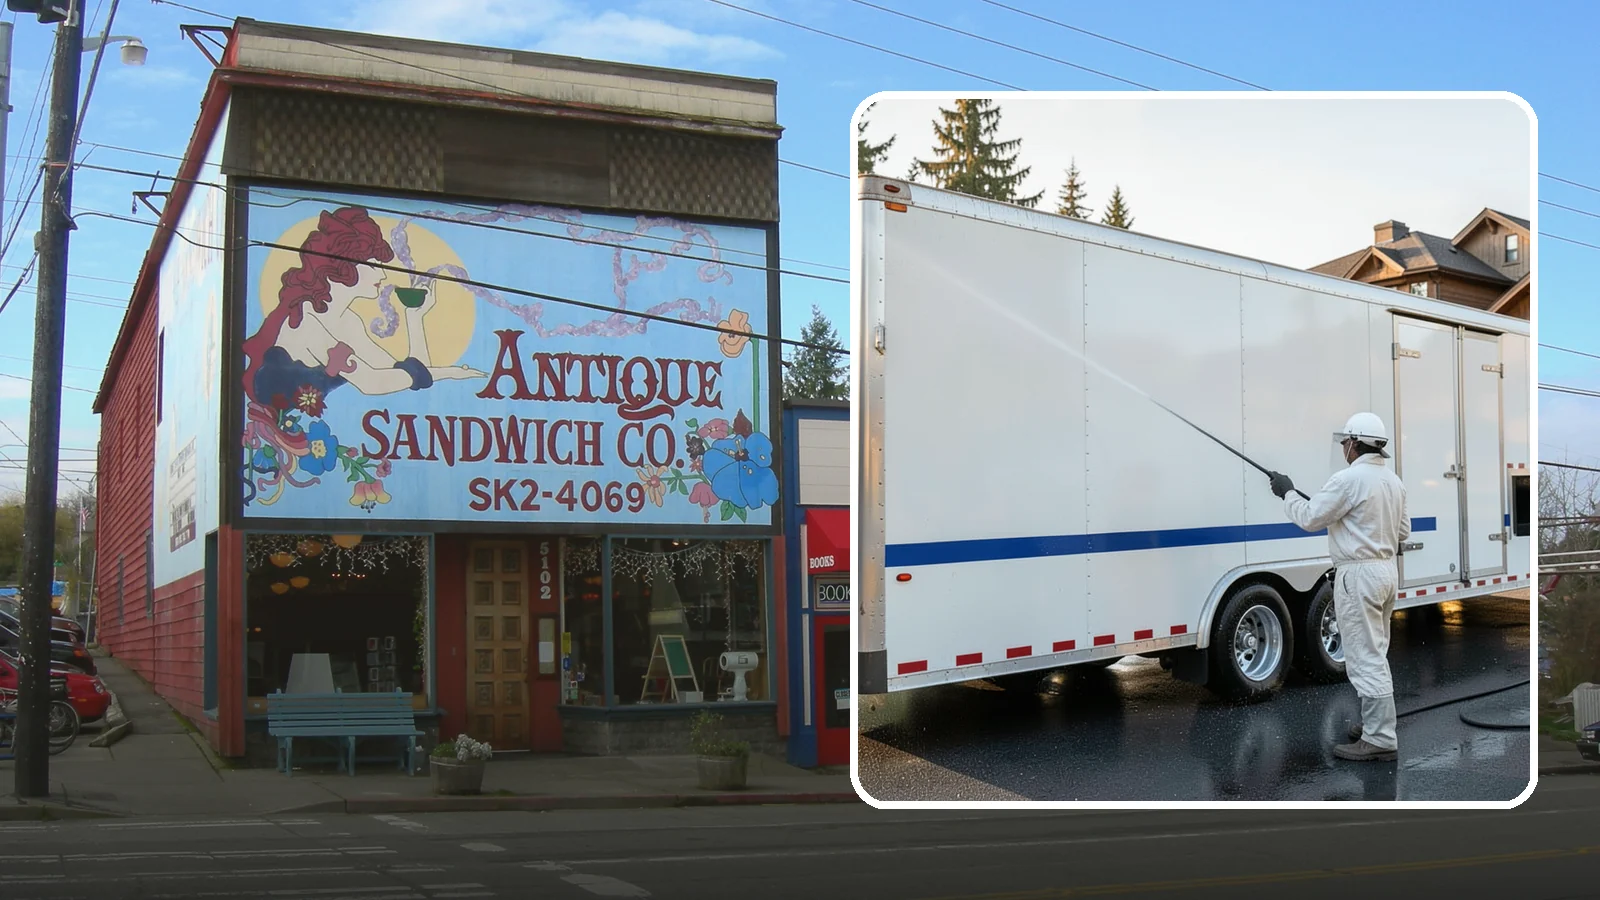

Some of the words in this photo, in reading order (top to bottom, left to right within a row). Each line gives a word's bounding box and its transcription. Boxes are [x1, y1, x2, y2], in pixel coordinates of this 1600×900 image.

[477, 330, 723, 420] ANTIQUE
[361, 409, 605, 466] SANDWICH
[617, 423, 685, 468] CO.
[468, 477, 646, 513] SK2-4069
[540, 542, 552, 600] 5102
[809, 555, 834, 568] BOOKS
